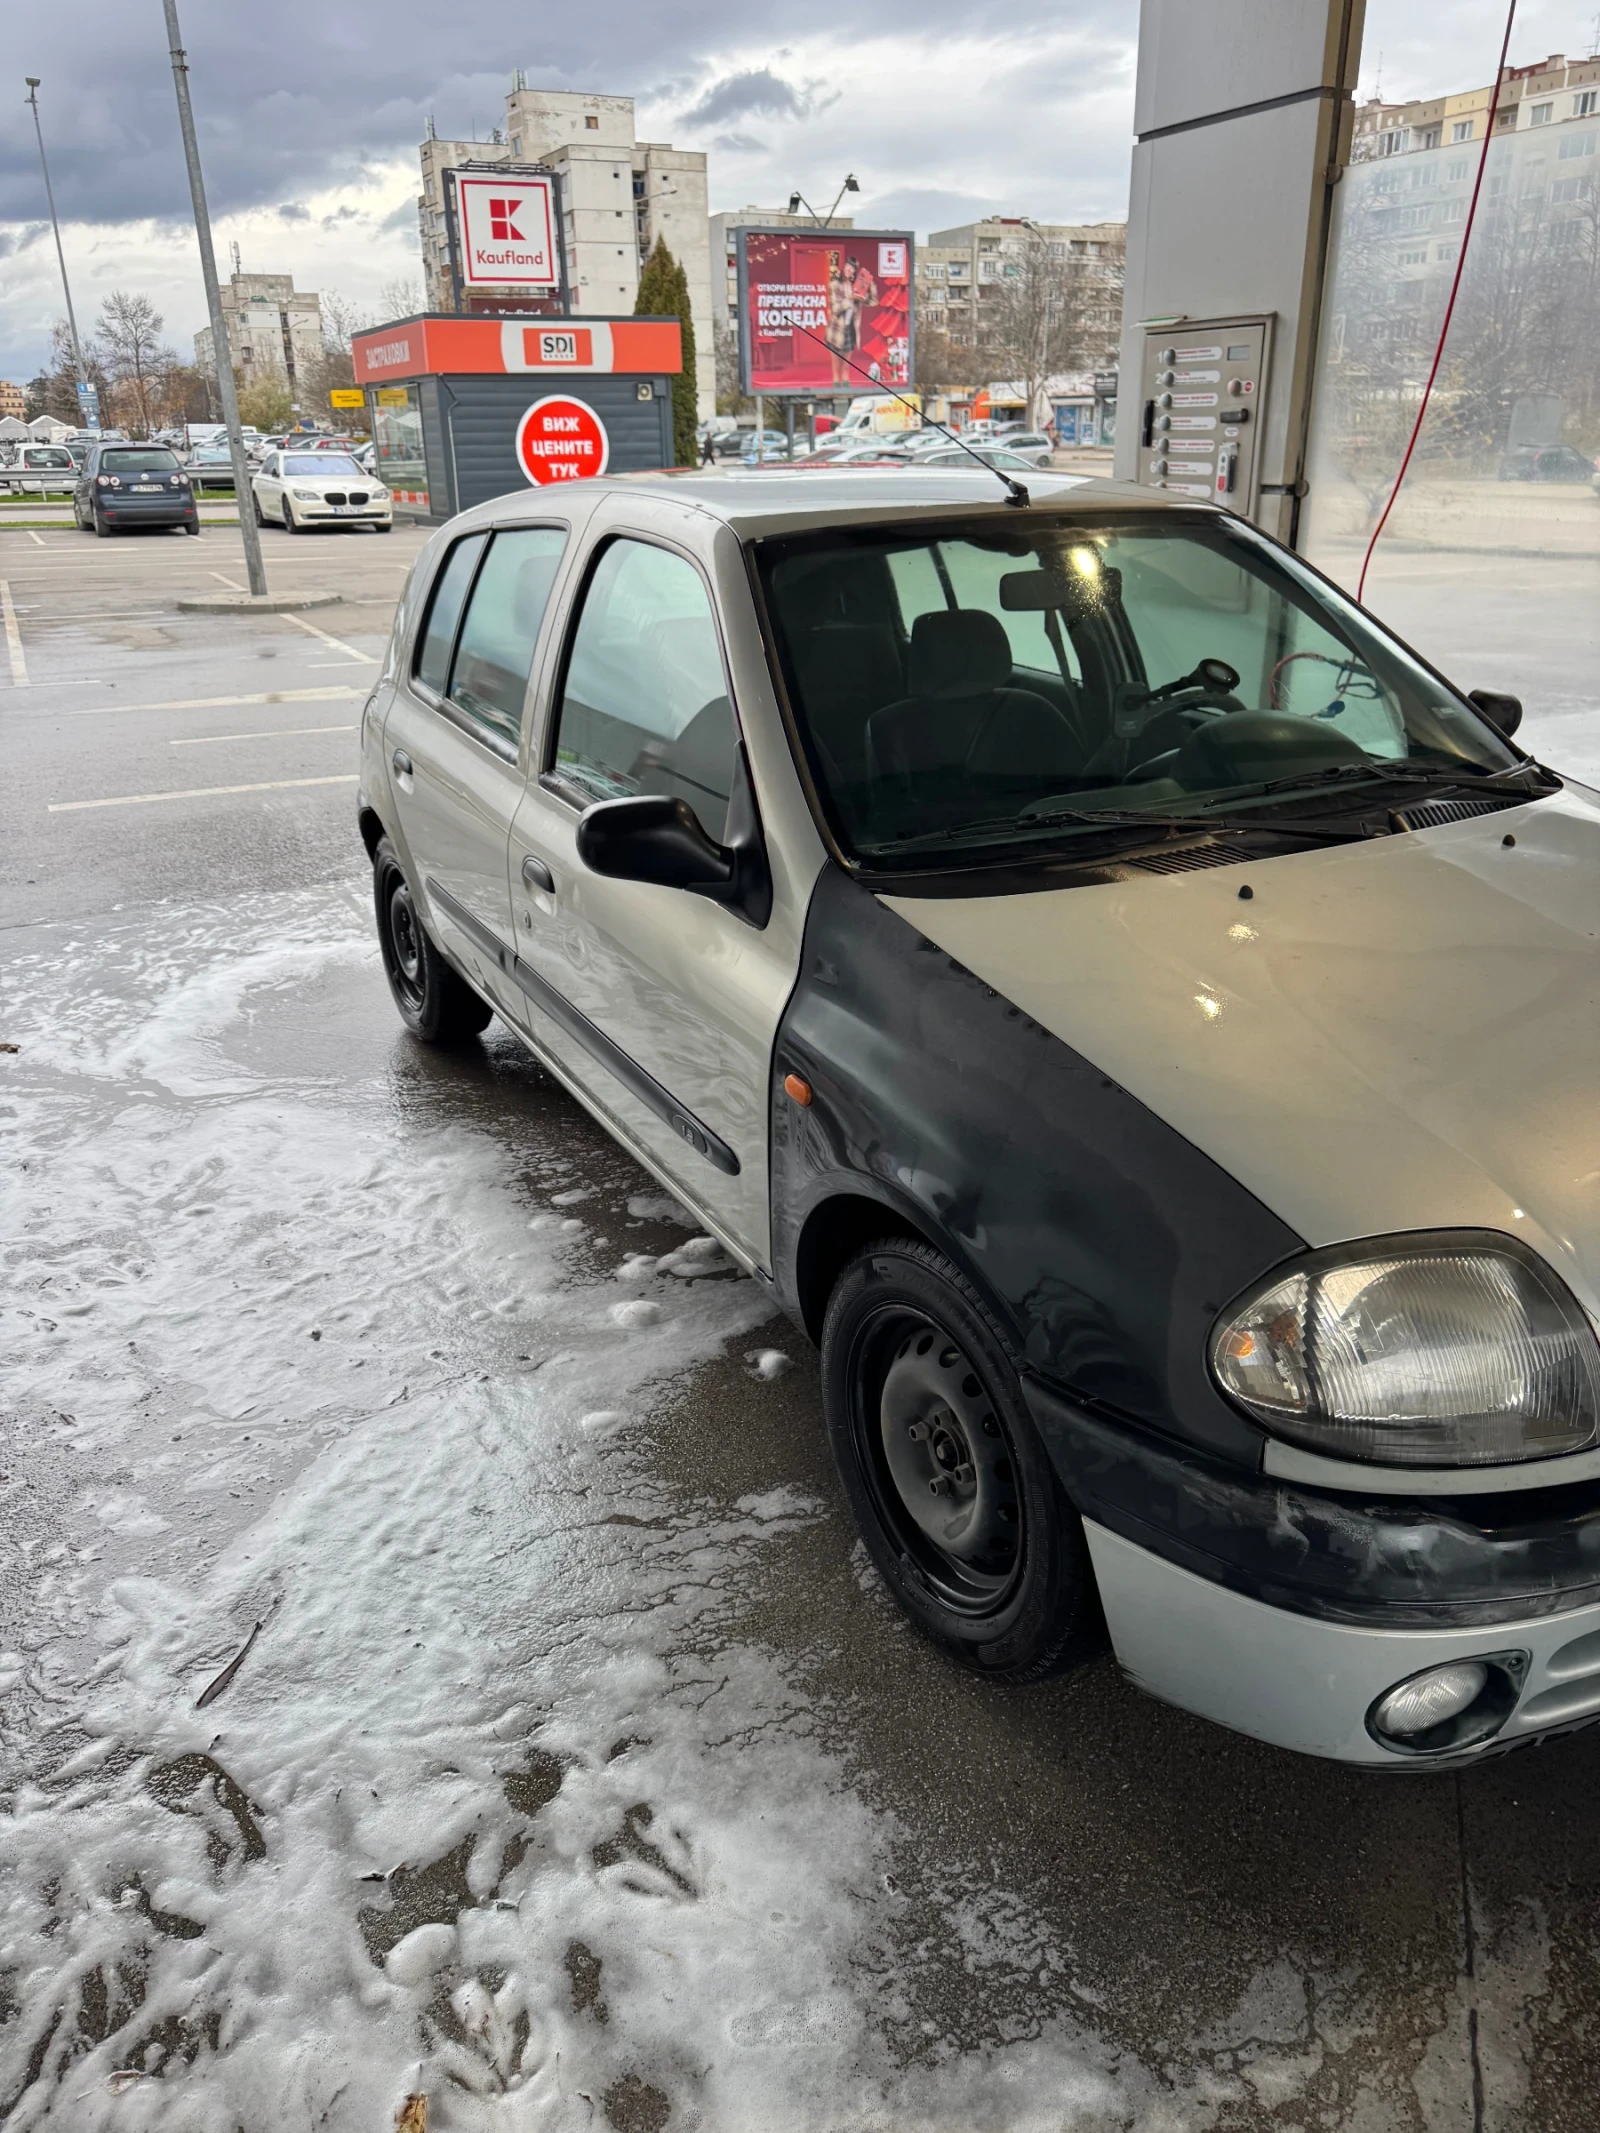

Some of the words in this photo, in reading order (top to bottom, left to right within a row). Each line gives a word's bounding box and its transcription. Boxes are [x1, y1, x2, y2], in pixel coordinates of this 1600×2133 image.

[477, 249, 544, 266] Kaufland
[757, 284, 786, 292] ОТВОРИ
[757, 295, 827, 308] ПРЕКРАСНА
[758, 310, 828, 329] КОЛЕДА
[543, 336, 574, 353] SDI
[366, 340, 410, 370] ЗАСТРАХОВКИ
[1155, 373, 1163, 384] 2
[542, 417, 580, 432] ВИЖ
[532, 439, 593, 457] ЦЕНИТЕ
[549, 463, 579, 478] ТУК
